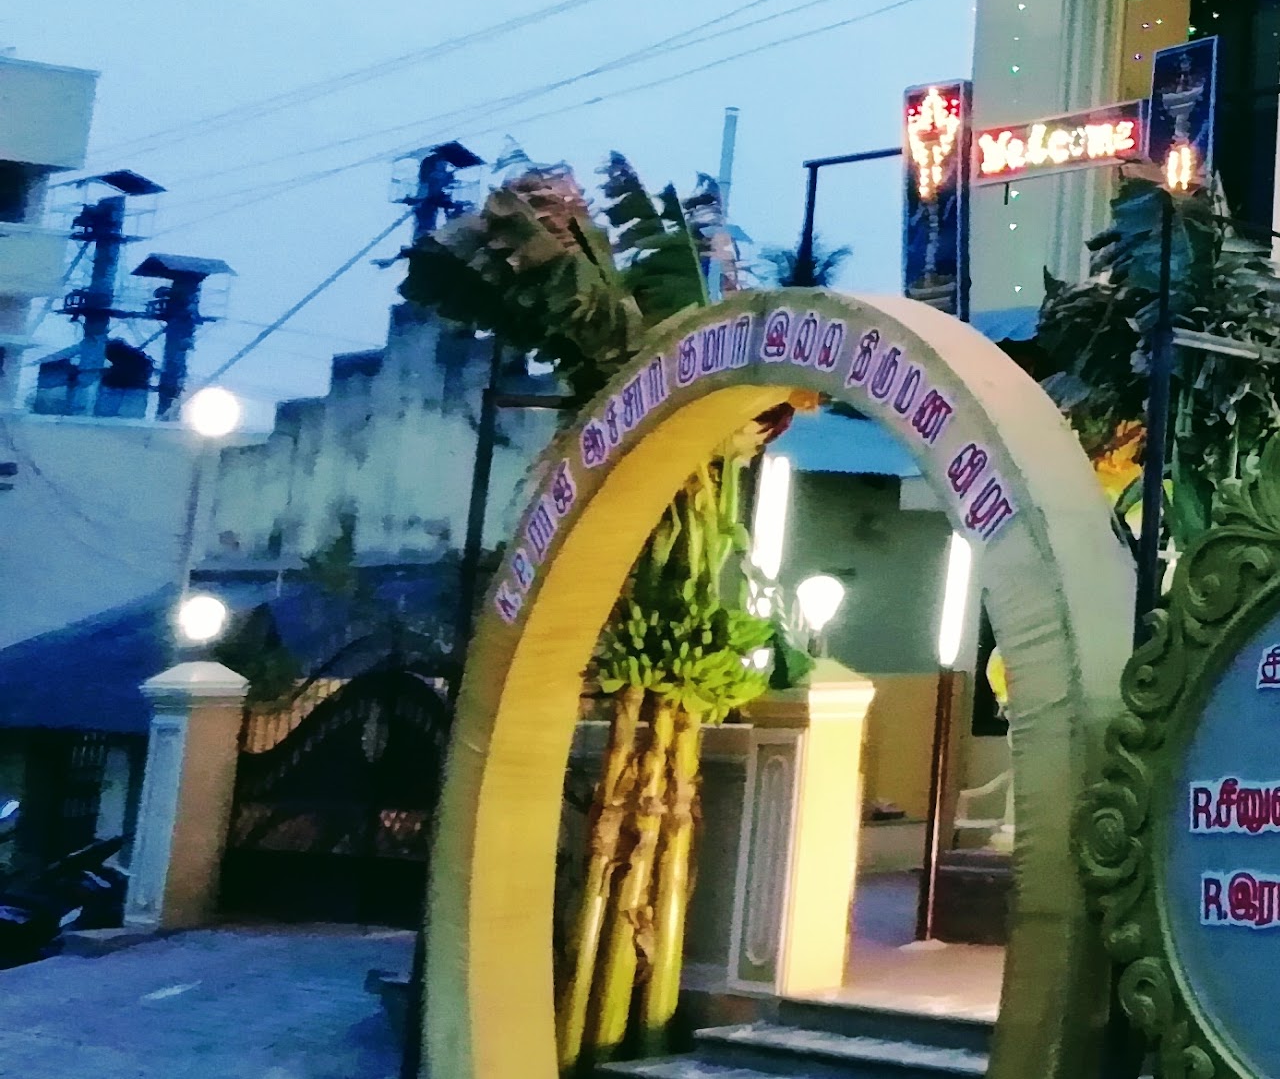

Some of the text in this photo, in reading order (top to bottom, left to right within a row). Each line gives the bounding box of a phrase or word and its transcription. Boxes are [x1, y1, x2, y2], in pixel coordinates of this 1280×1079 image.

[763, 310, 843, 368] இல்ல
[849, 328, 954, 445] திருமண
[947, 442, 1013, 541] விழா
